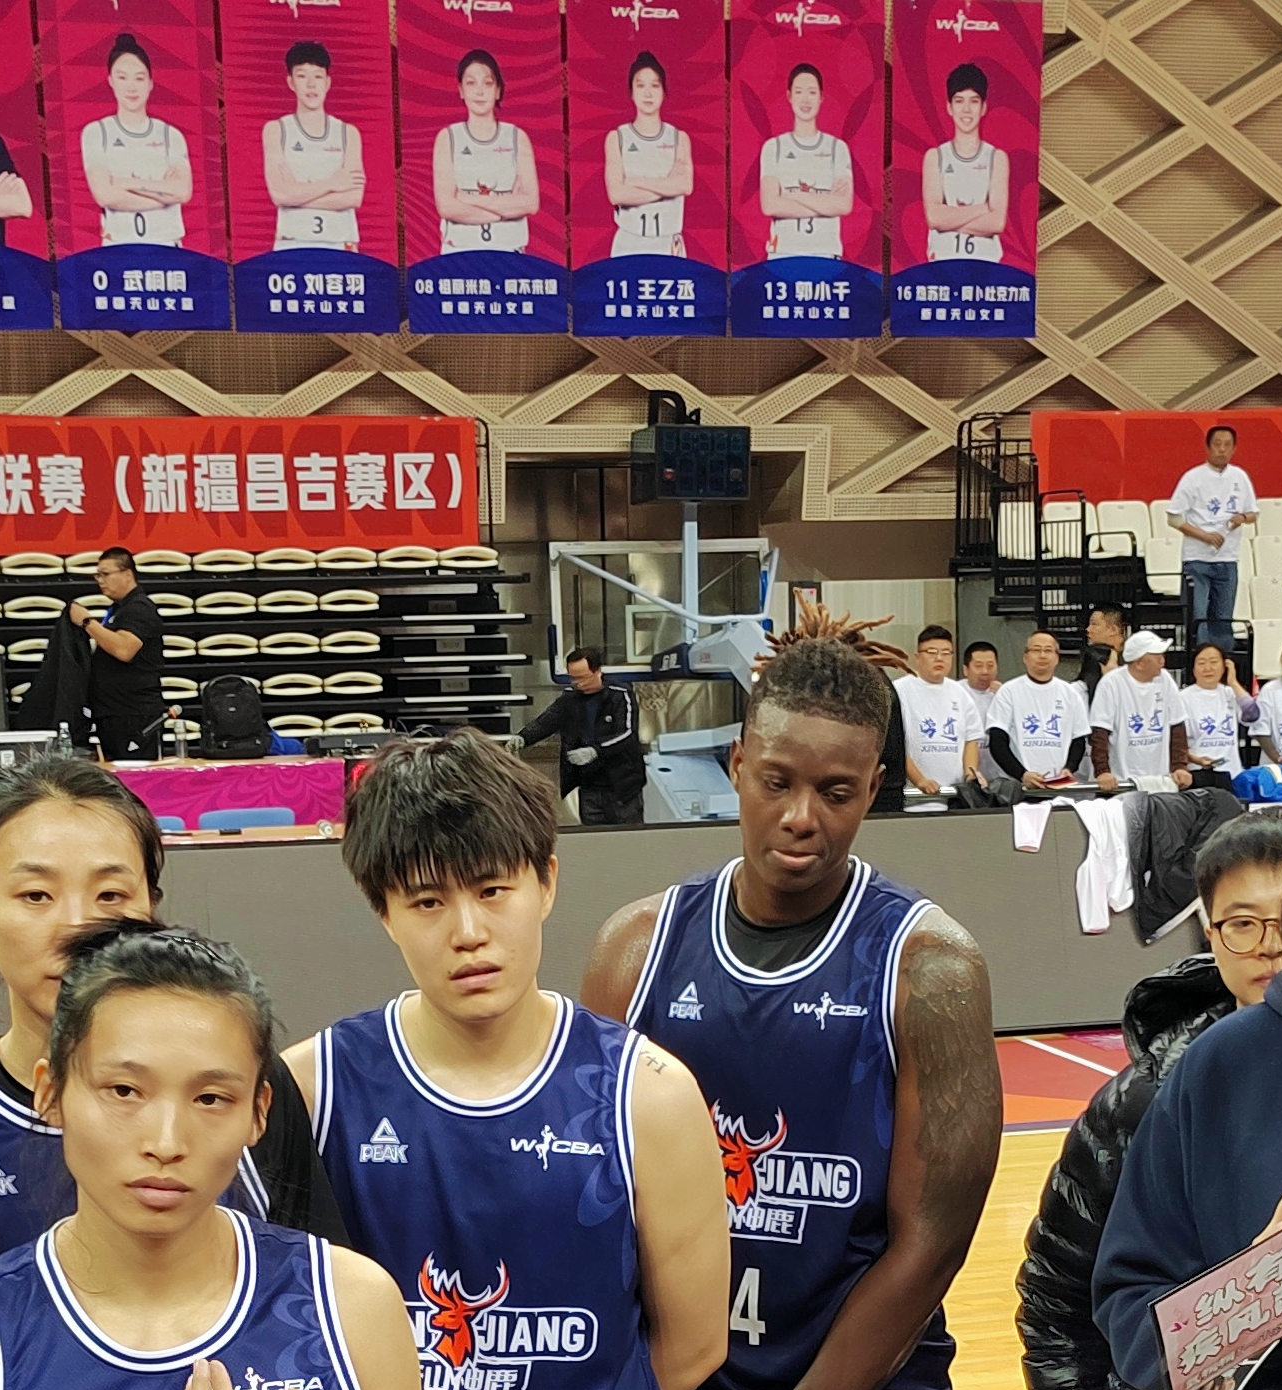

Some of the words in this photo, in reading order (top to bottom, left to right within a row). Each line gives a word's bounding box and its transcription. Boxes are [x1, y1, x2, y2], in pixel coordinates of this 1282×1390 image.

[92, 270, 109, 291] 0
[268, 273, 297, 294] 06
[414, 278, 435, 295] 08
[606, 279, 628, 299] 11
[764, 281, 788, 301] 13
[896, 285, 912, 301] 16
[668, 1001, 705, 1021] PEAK
[793, 1000, 869, 1018] WCBA
[359, 1143, 409, 1164] PEAK
[510, 1136, 607, 1157] WCBA
